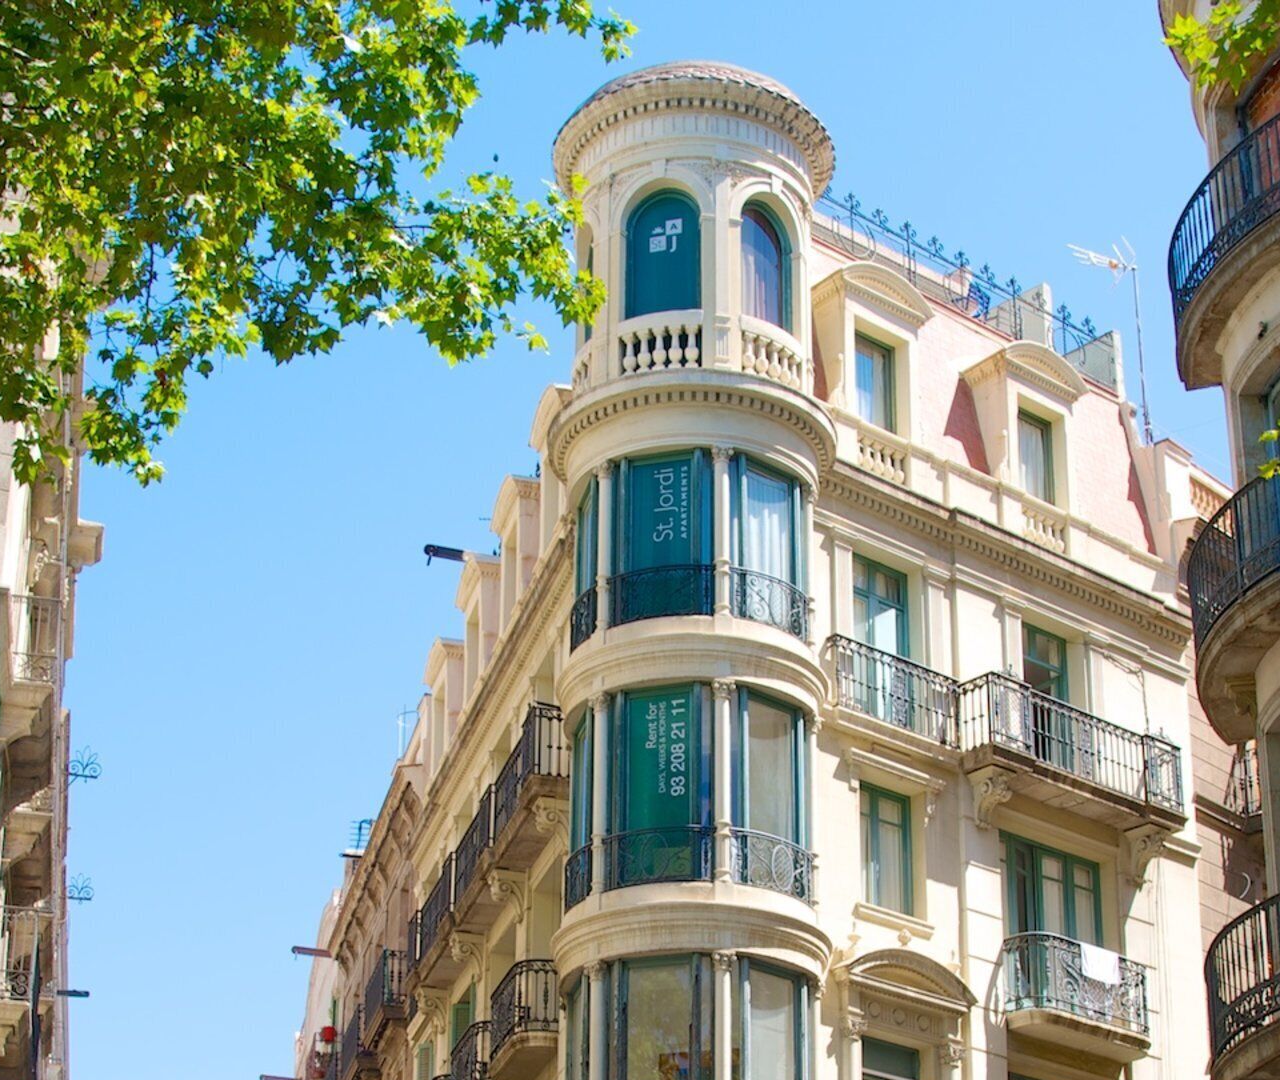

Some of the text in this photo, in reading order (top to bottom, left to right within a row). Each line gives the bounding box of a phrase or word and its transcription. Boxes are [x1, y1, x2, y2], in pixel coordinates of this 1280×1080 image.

[653, 468, 679, 542] St. Jordi
[680, 466, 688, 539] APARTAMENTS
[645, 702, 657, 749] Rent for
[670, 699, 686, 796] 93 208 21 11
